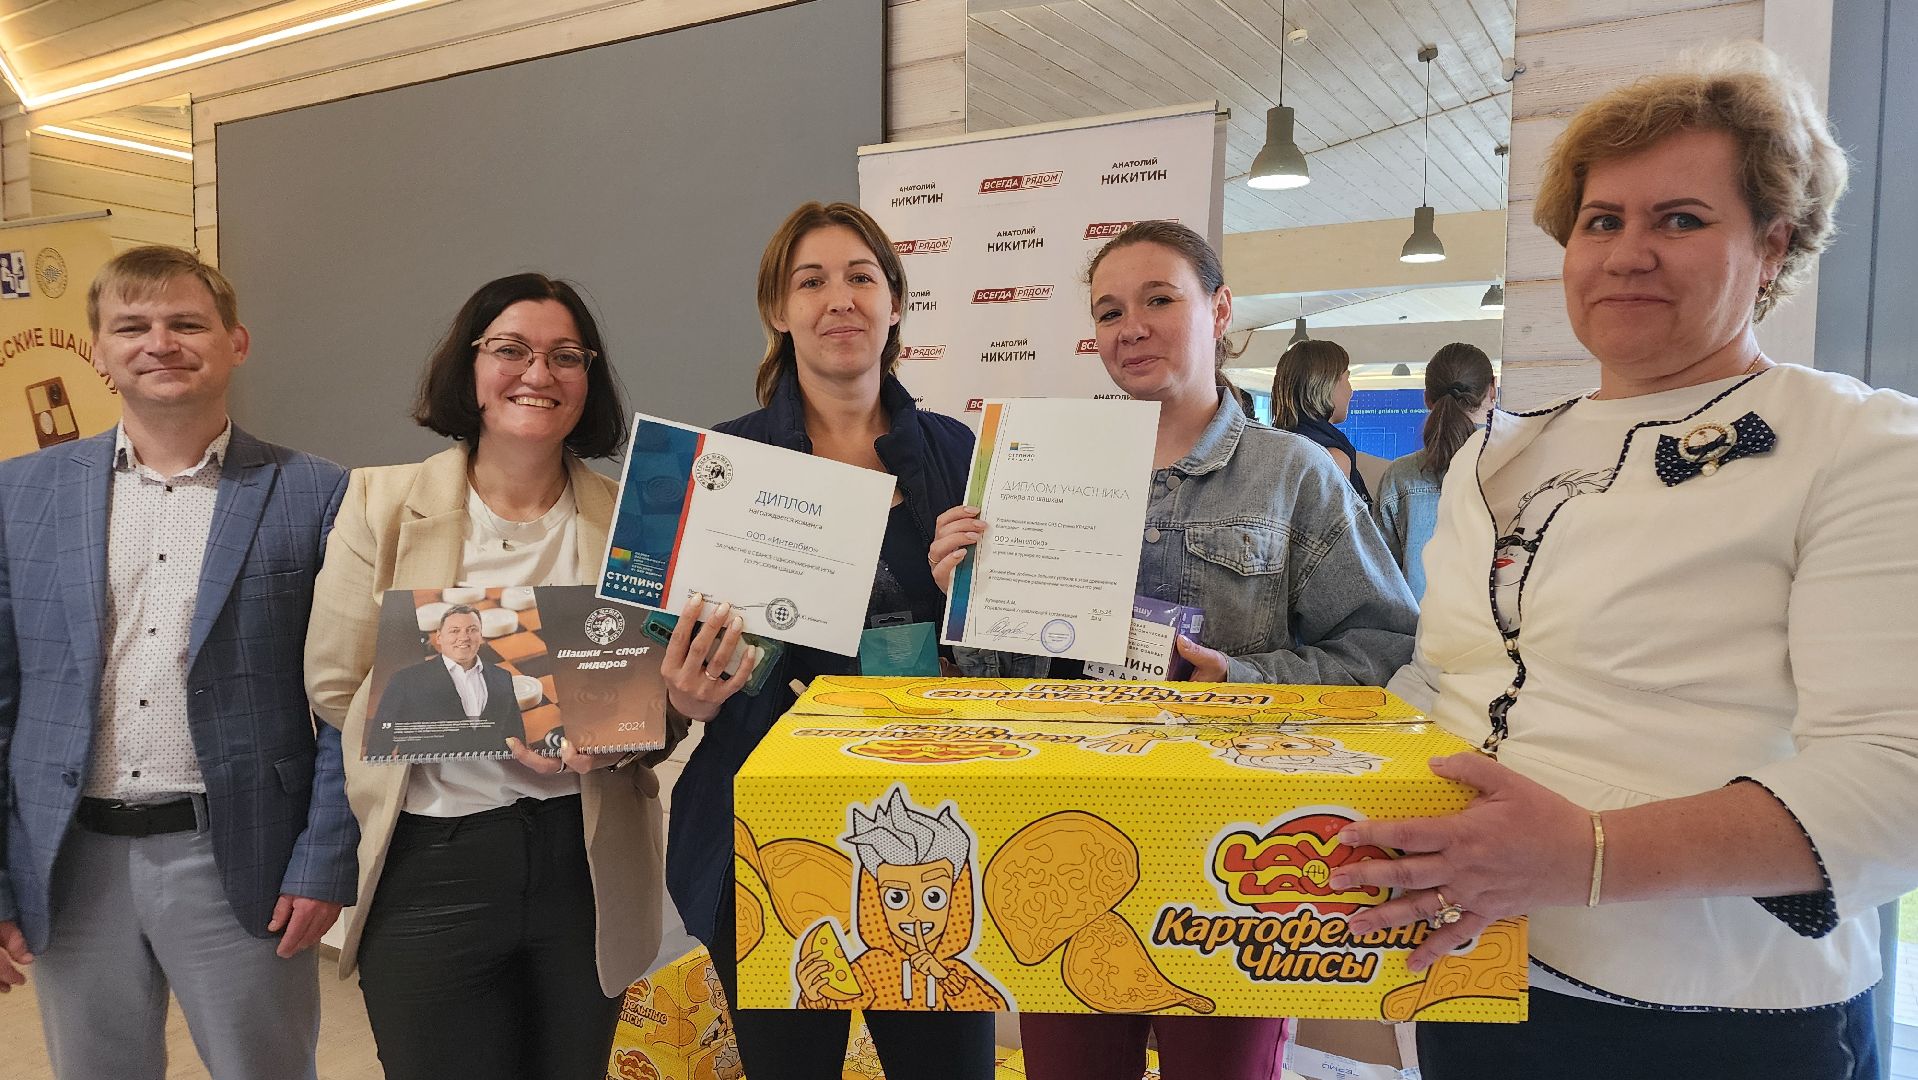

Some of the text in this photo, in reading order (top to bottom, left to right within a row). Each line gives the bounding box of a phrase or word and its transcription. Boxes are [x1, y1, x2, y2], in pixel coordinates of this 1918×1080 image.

[1111, 157, 1158, 169] АНАТОЛИЙ
[983, 173, 1059, 190] ВСЕГДА РЯДОМ
[1101, 169, 1168, 185] НИКИТИН
[899, 182, 936, 193] АНАТОЛИЙ
[891, 193, 944, 208] НИКИТИН
[997, 226, 1037, 237] АНАТОЛИЙ
[918, 239, 949, 250] РЯДОМ
[987, 238, 1044, 253] НИКИТИН
[977, 287, 1050, 300] ВСЕГДА РЯДОМ
[908, 301, 937, 312] ИТИН
[990, 338, 1028, 348] АНАТОЛИЙ
[912, 347, 943, 356] РЯДОМ
[980, 350, 1036, 363] НИКИТИН
[1002, 480, 1057, 494] ДИПЛОМ
[755, 490, 822, 517] ДИПЛОМ
[606, 571, 664, 591] СТУПИНО
[605, 582, 661, 599] КВАДРАТ
[1133, 606, 1153, 617] ашу
[557, 649, 602, 659] Шашки
[615, 646, 650, 657] спорт
[576, 659, 628, 670] лидеров
[617, 721, 646, 732] 2024
[1236, 942, 1379, 982] Чипсы
